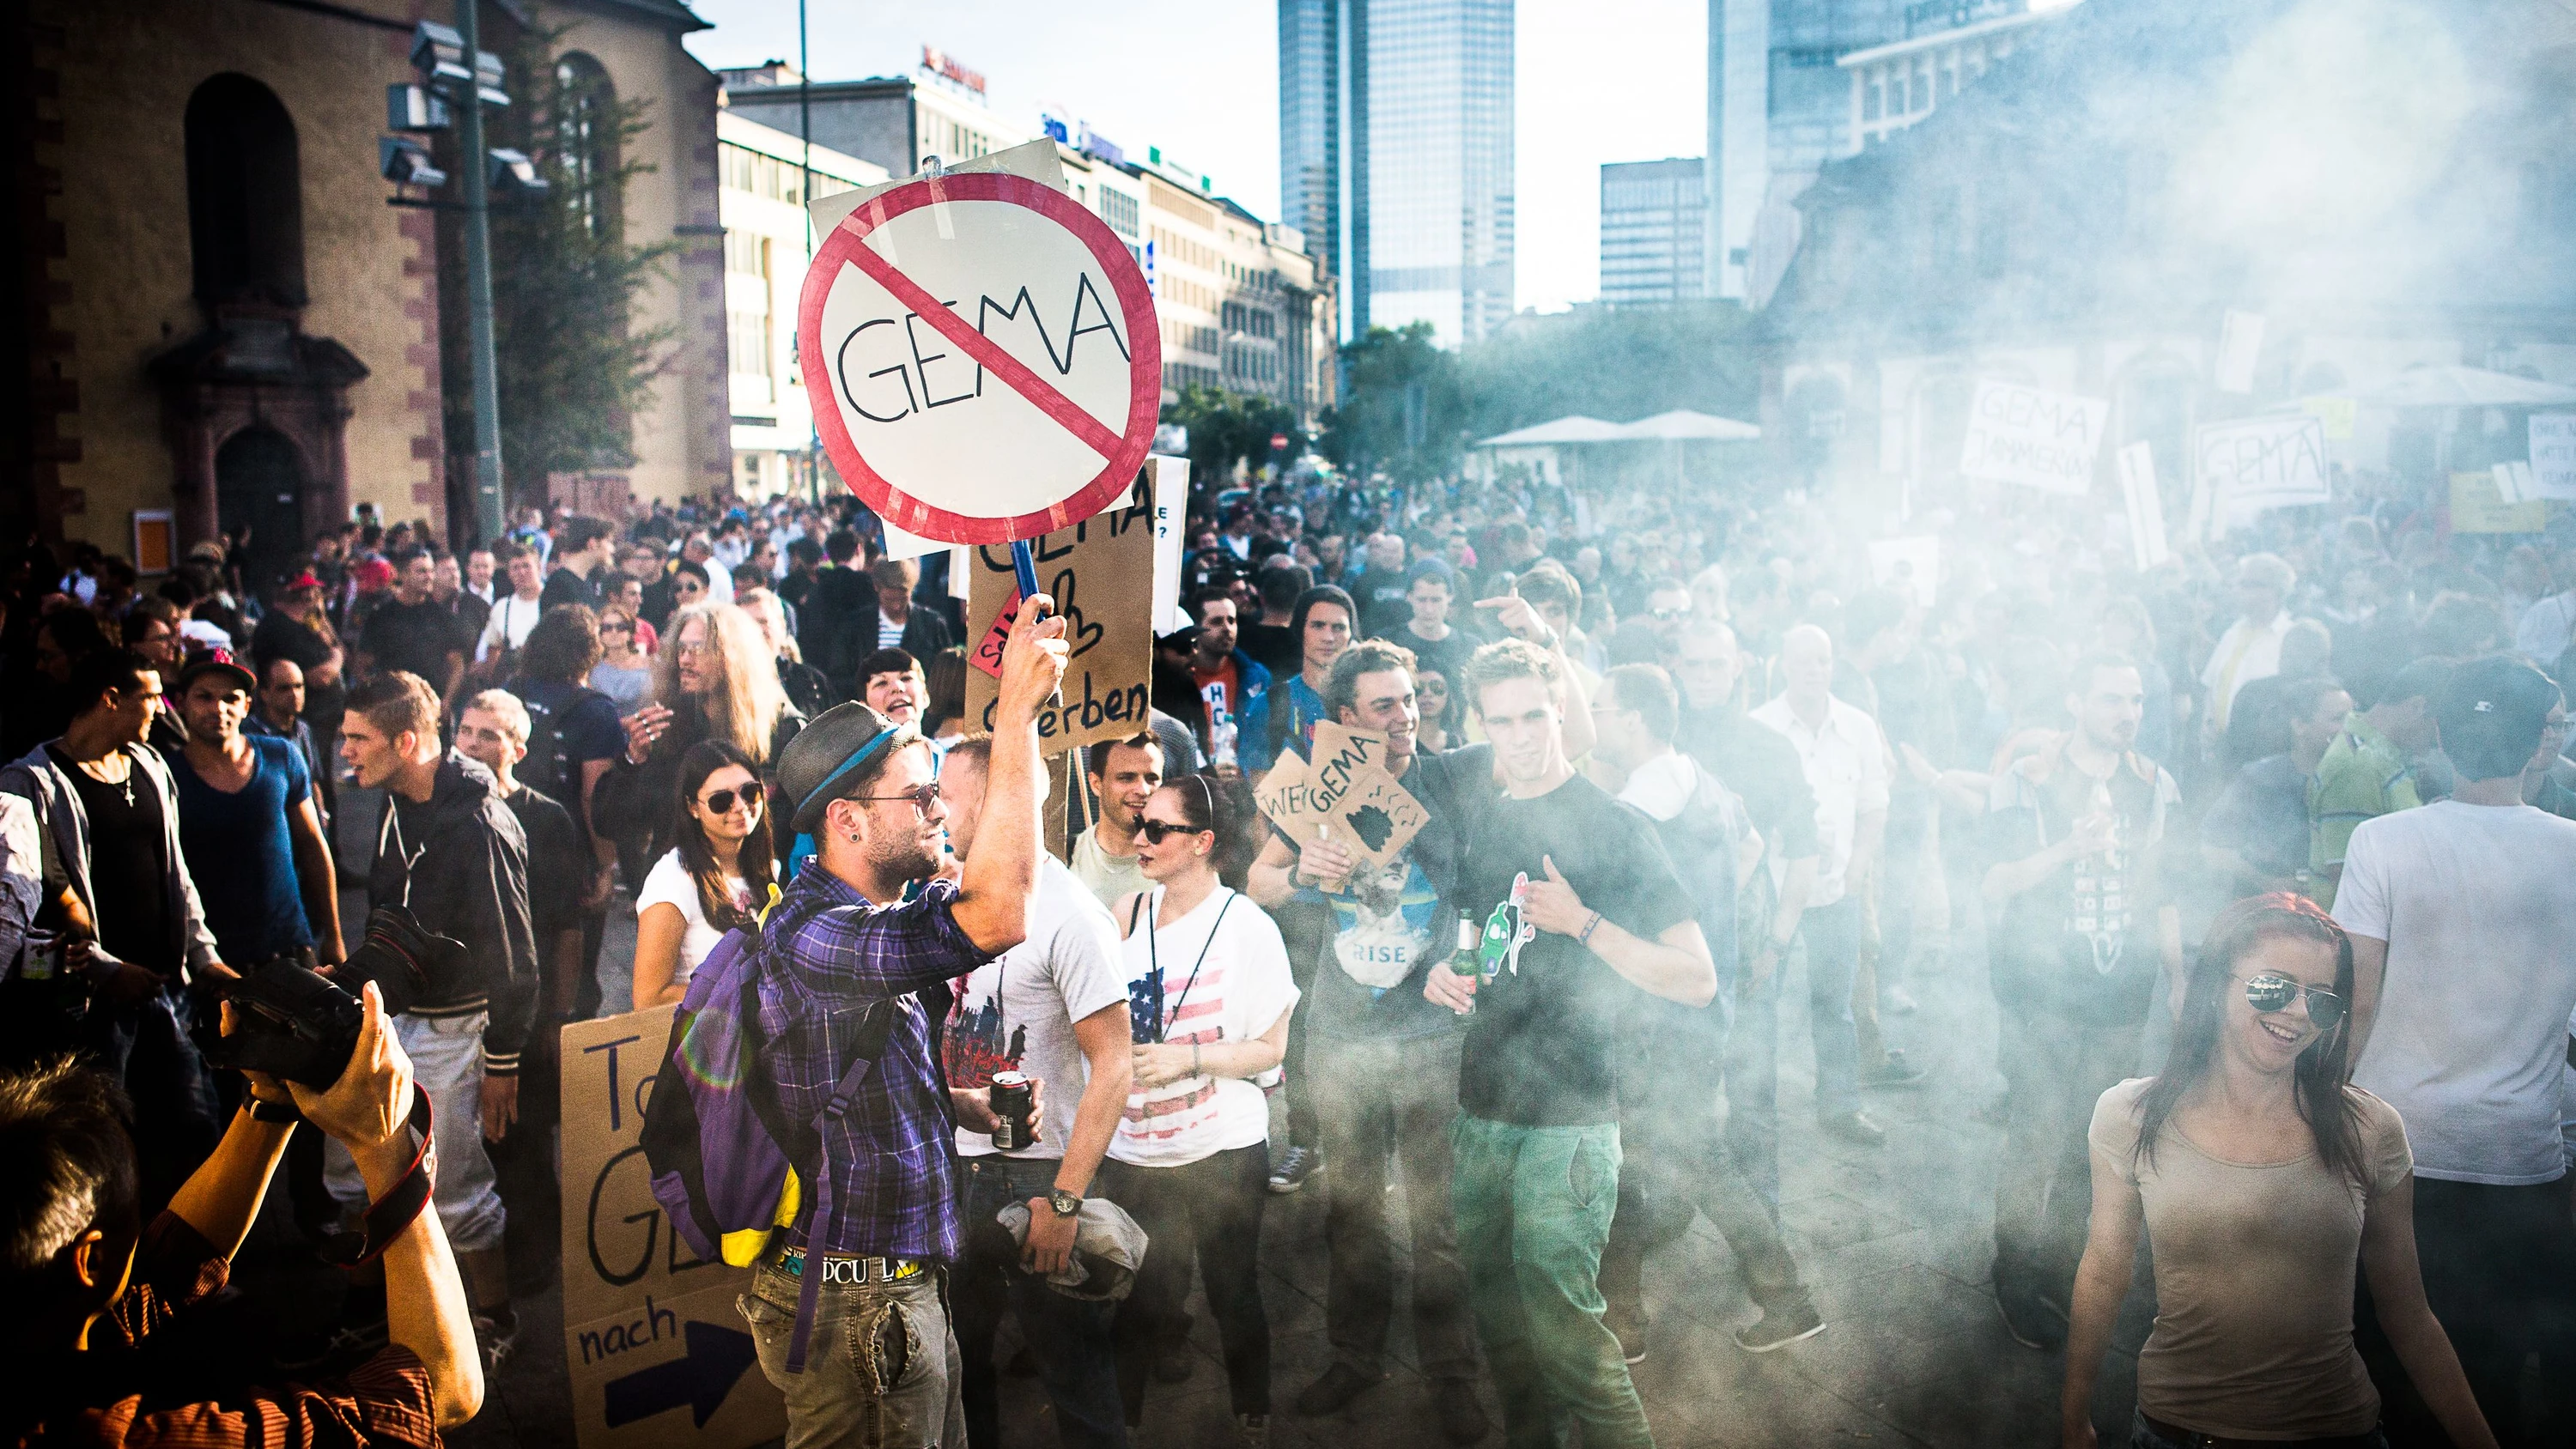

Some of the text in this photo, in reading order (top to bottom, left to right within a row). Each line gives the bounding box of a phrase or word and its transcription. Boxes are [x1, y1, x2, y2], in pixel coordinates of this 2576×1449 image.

[837, 272, 1131, 422] GEMA
[1981, 386, 2087, 445] GEMA
[2204, 428, 2322, 485] GEMA
[983, 670, 1149, 737] erben
[1309, 736, 1380, 812] GEMA
[1353, 945, 1406, 963] RISE
[578, 1294, 677, 1365] nach
